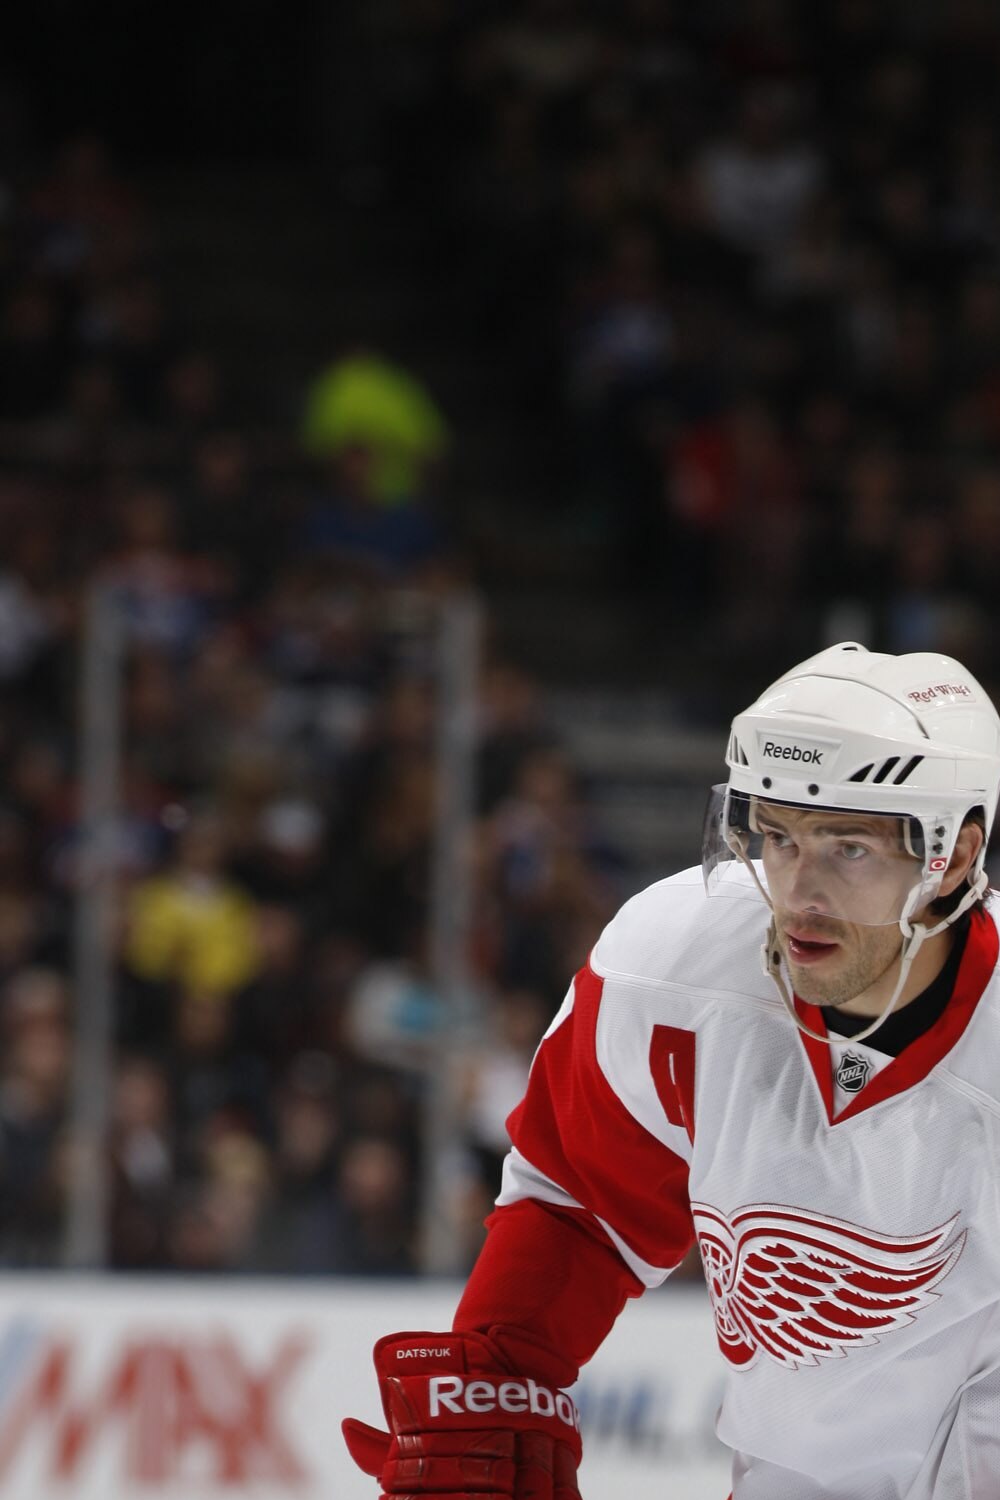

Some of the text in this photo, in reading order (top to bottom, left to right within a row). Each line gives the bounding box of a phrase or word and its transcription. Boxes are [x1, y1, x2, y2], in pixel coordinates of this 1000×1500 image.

[907, 687, 937, 702] Red
[763, 742, 824, 765] Reebok
[840, 1066, 863, 1081] NHL
[396, 1348, 450, 1360] DATSYUK
